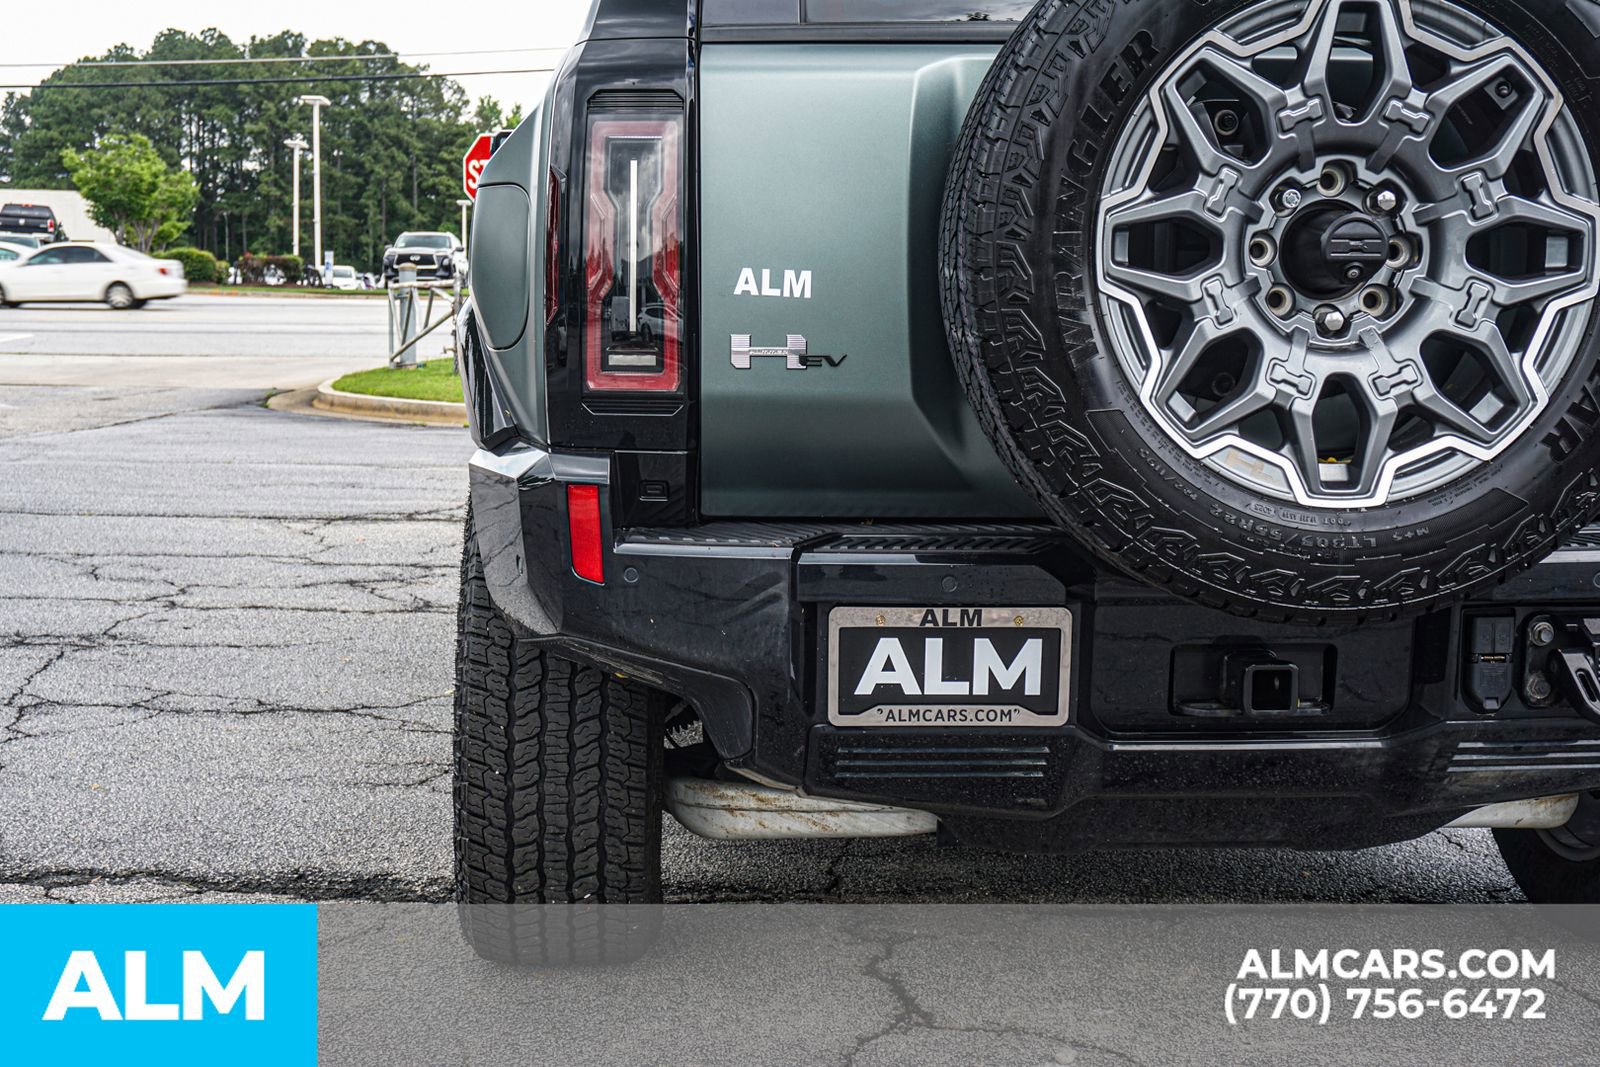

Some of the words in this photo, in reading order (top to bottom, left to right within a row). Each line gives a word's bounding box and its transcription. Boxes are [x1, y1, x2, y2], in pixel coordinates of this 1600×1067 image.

[467, 159, 490, 189] S
[1052, 29, 1160, 370] WRANGLER
[733, 267, 812, 298] ALM
[919, 608, 983, 627] ALM
[853, 637, 1043, 696] ALM
